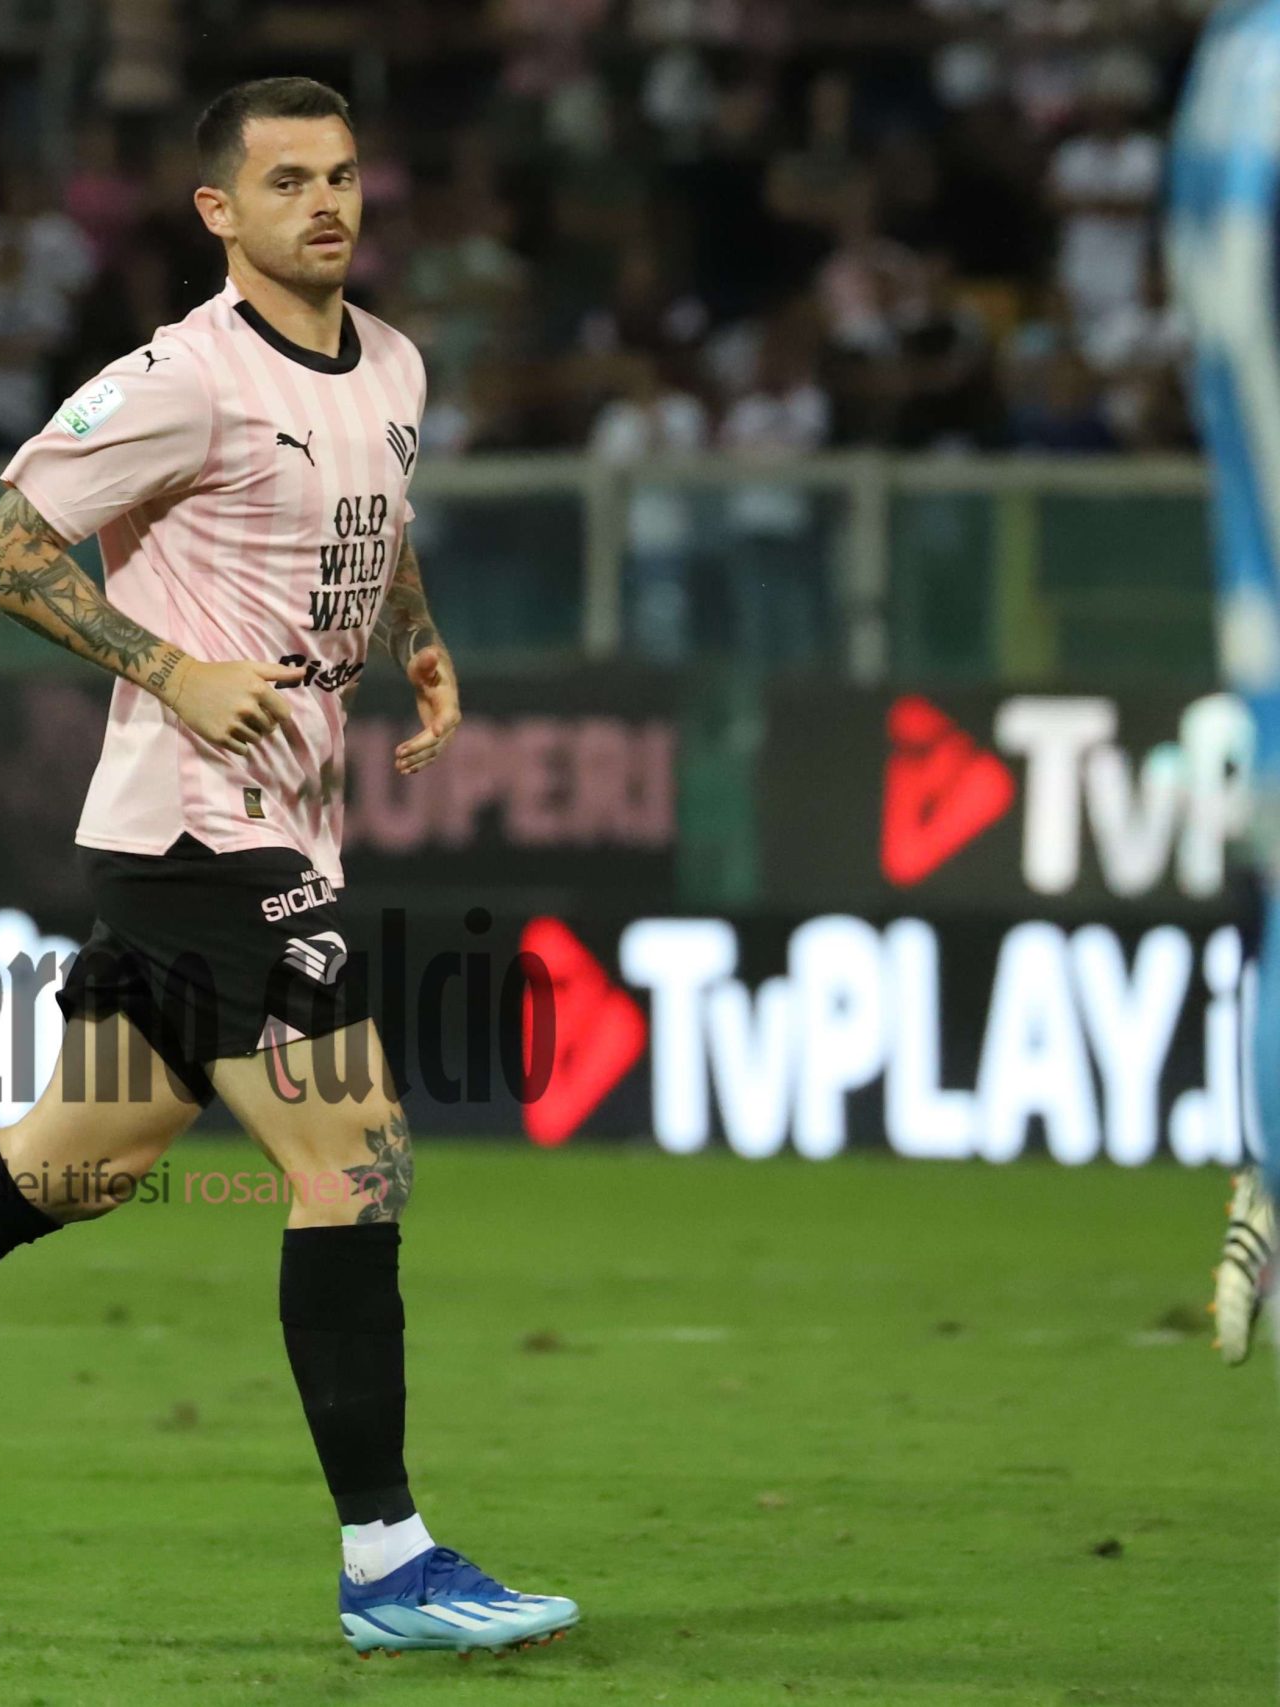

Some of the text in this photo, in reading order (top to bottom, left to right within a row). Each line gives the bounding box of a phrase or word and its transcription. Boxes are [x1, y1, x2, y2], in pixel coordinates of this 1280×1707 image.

[333, 493, 388, 539] OLD
[320, 539, 386, 586] WILD
[309, 585, 382, 632] WEST
